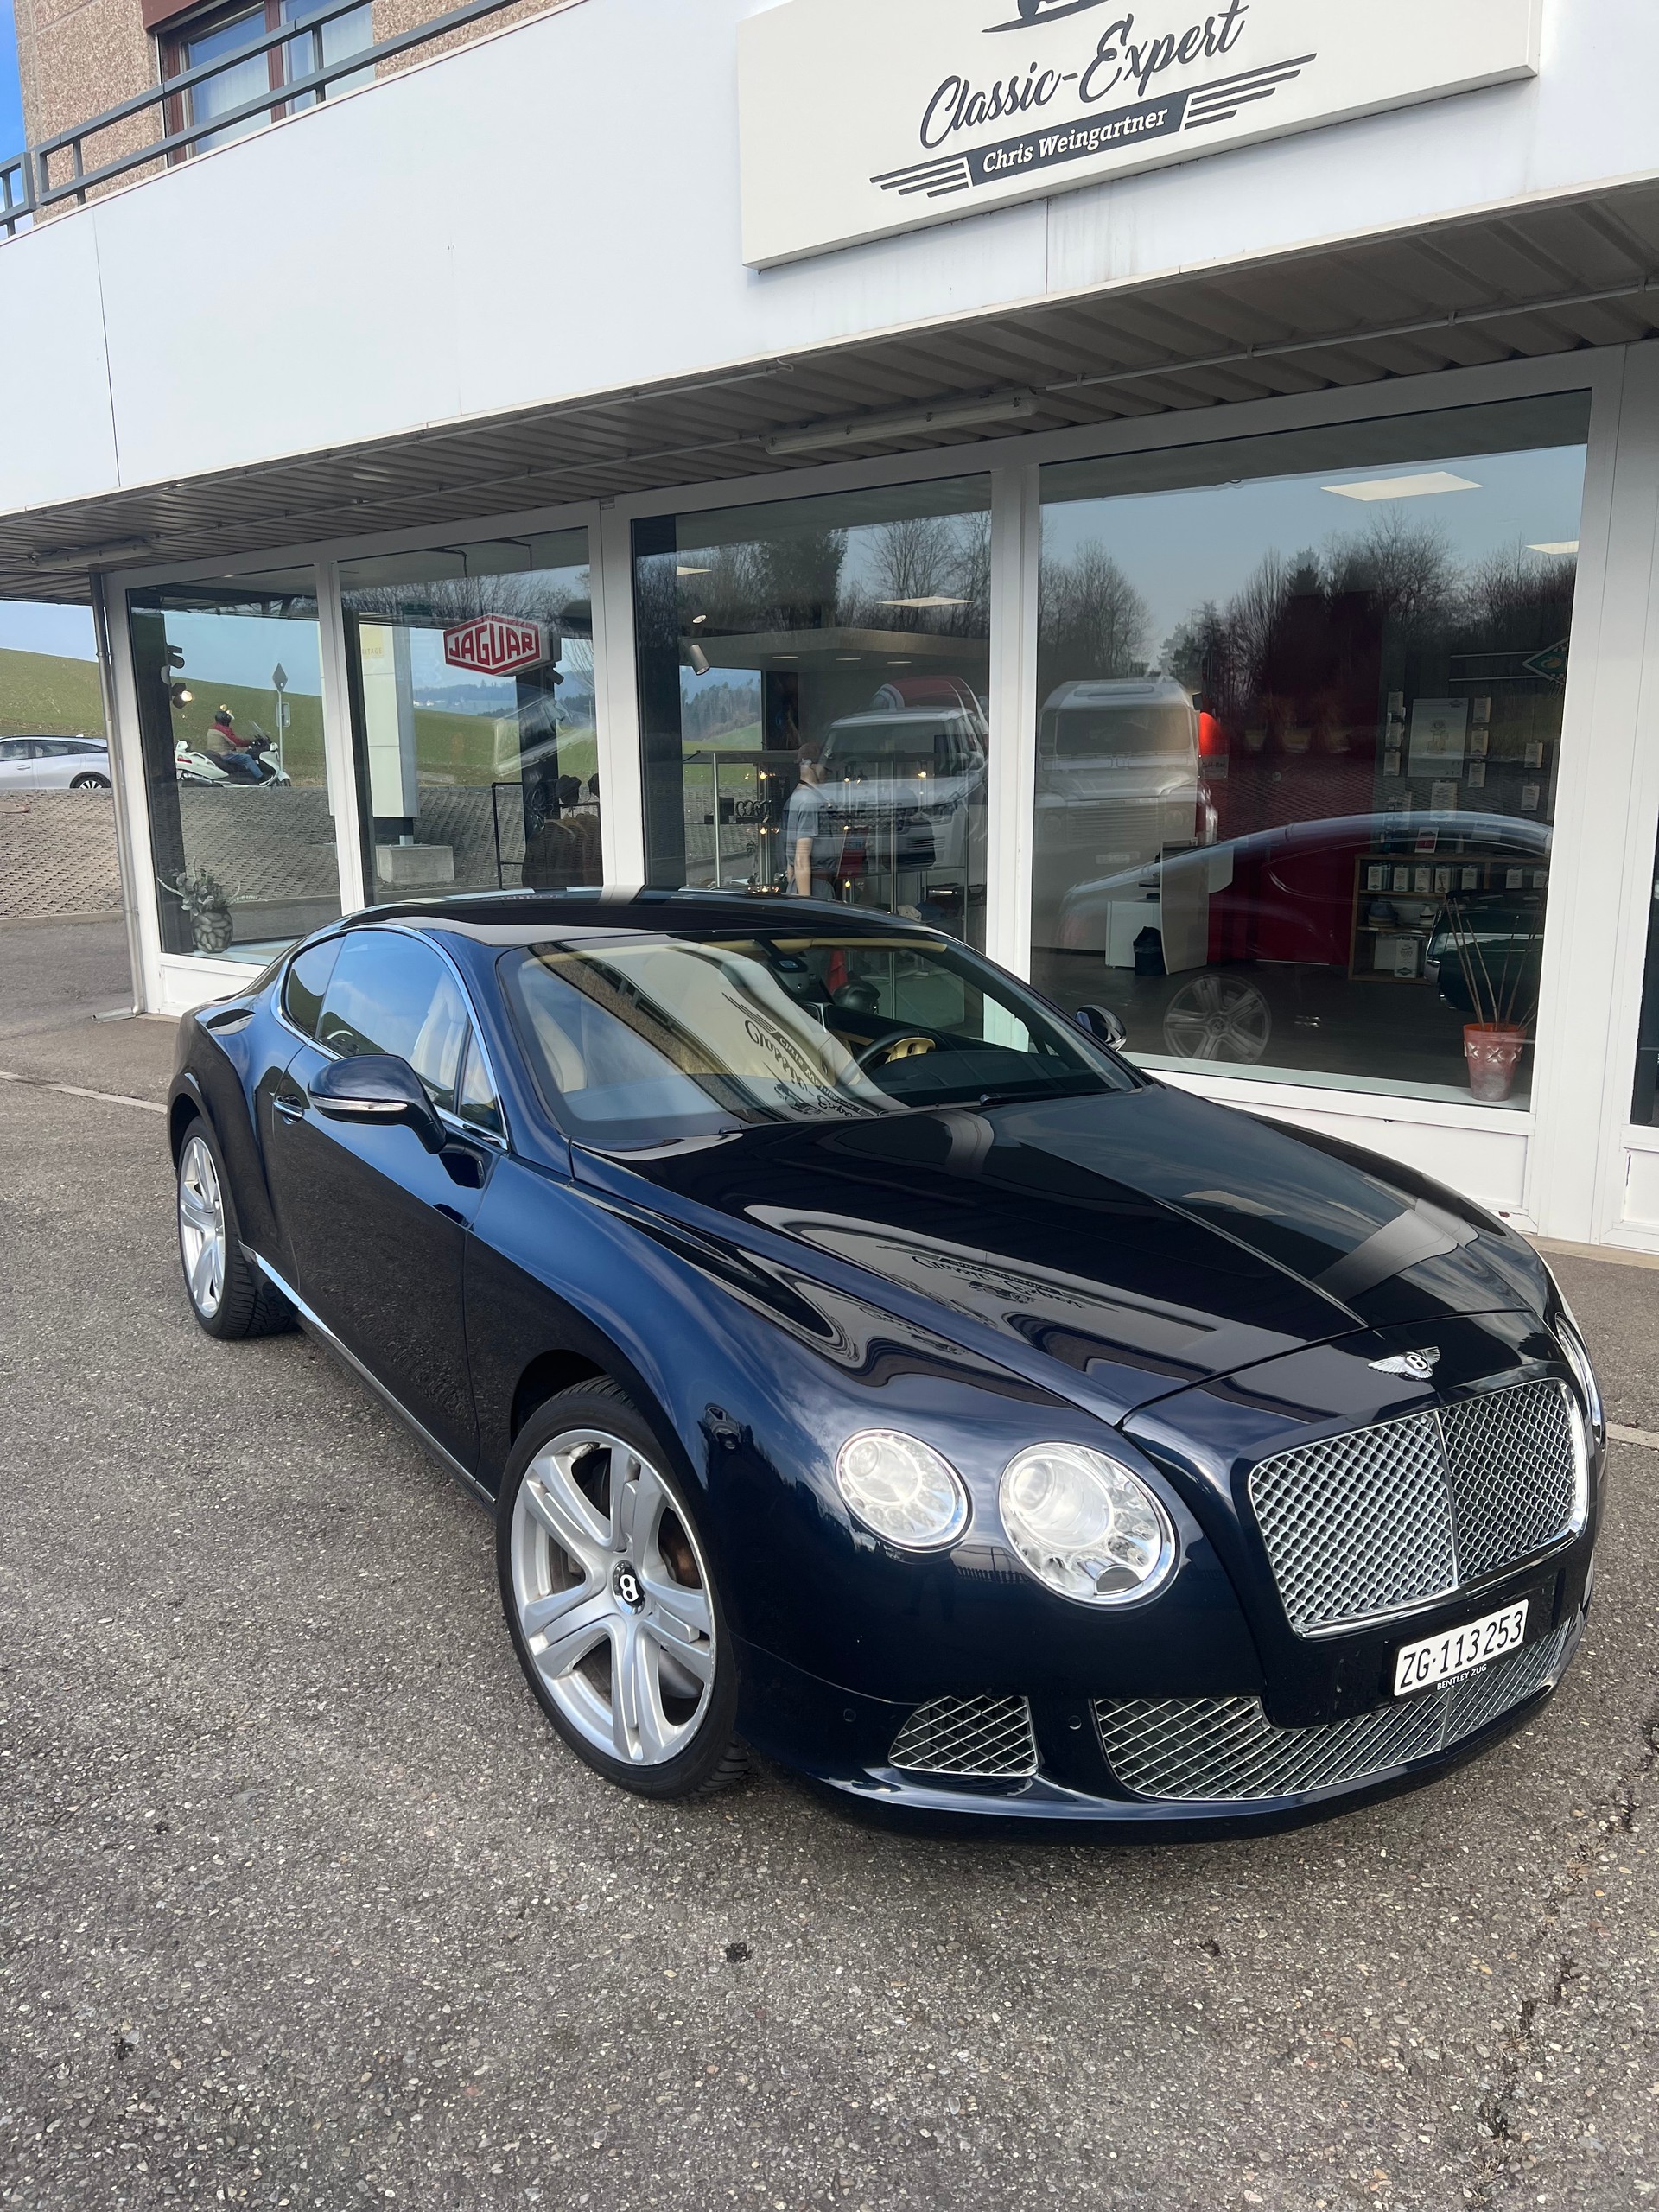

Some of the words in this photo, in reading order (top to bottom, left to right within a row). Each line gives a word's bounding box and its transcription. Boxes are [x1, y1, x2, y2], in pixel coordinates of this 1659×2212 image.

[919, 0, 1249, 149] Classic-Expert
[982, 141, 1033, 173] Chris
[1038, 107, 1168, 158] Weingartner
[448, 623, 535, 666] JAGUAR
[1436, 1671, 1470, 1691] BENTLEY
[1471, 1663, 1488, 1677] ZUG
